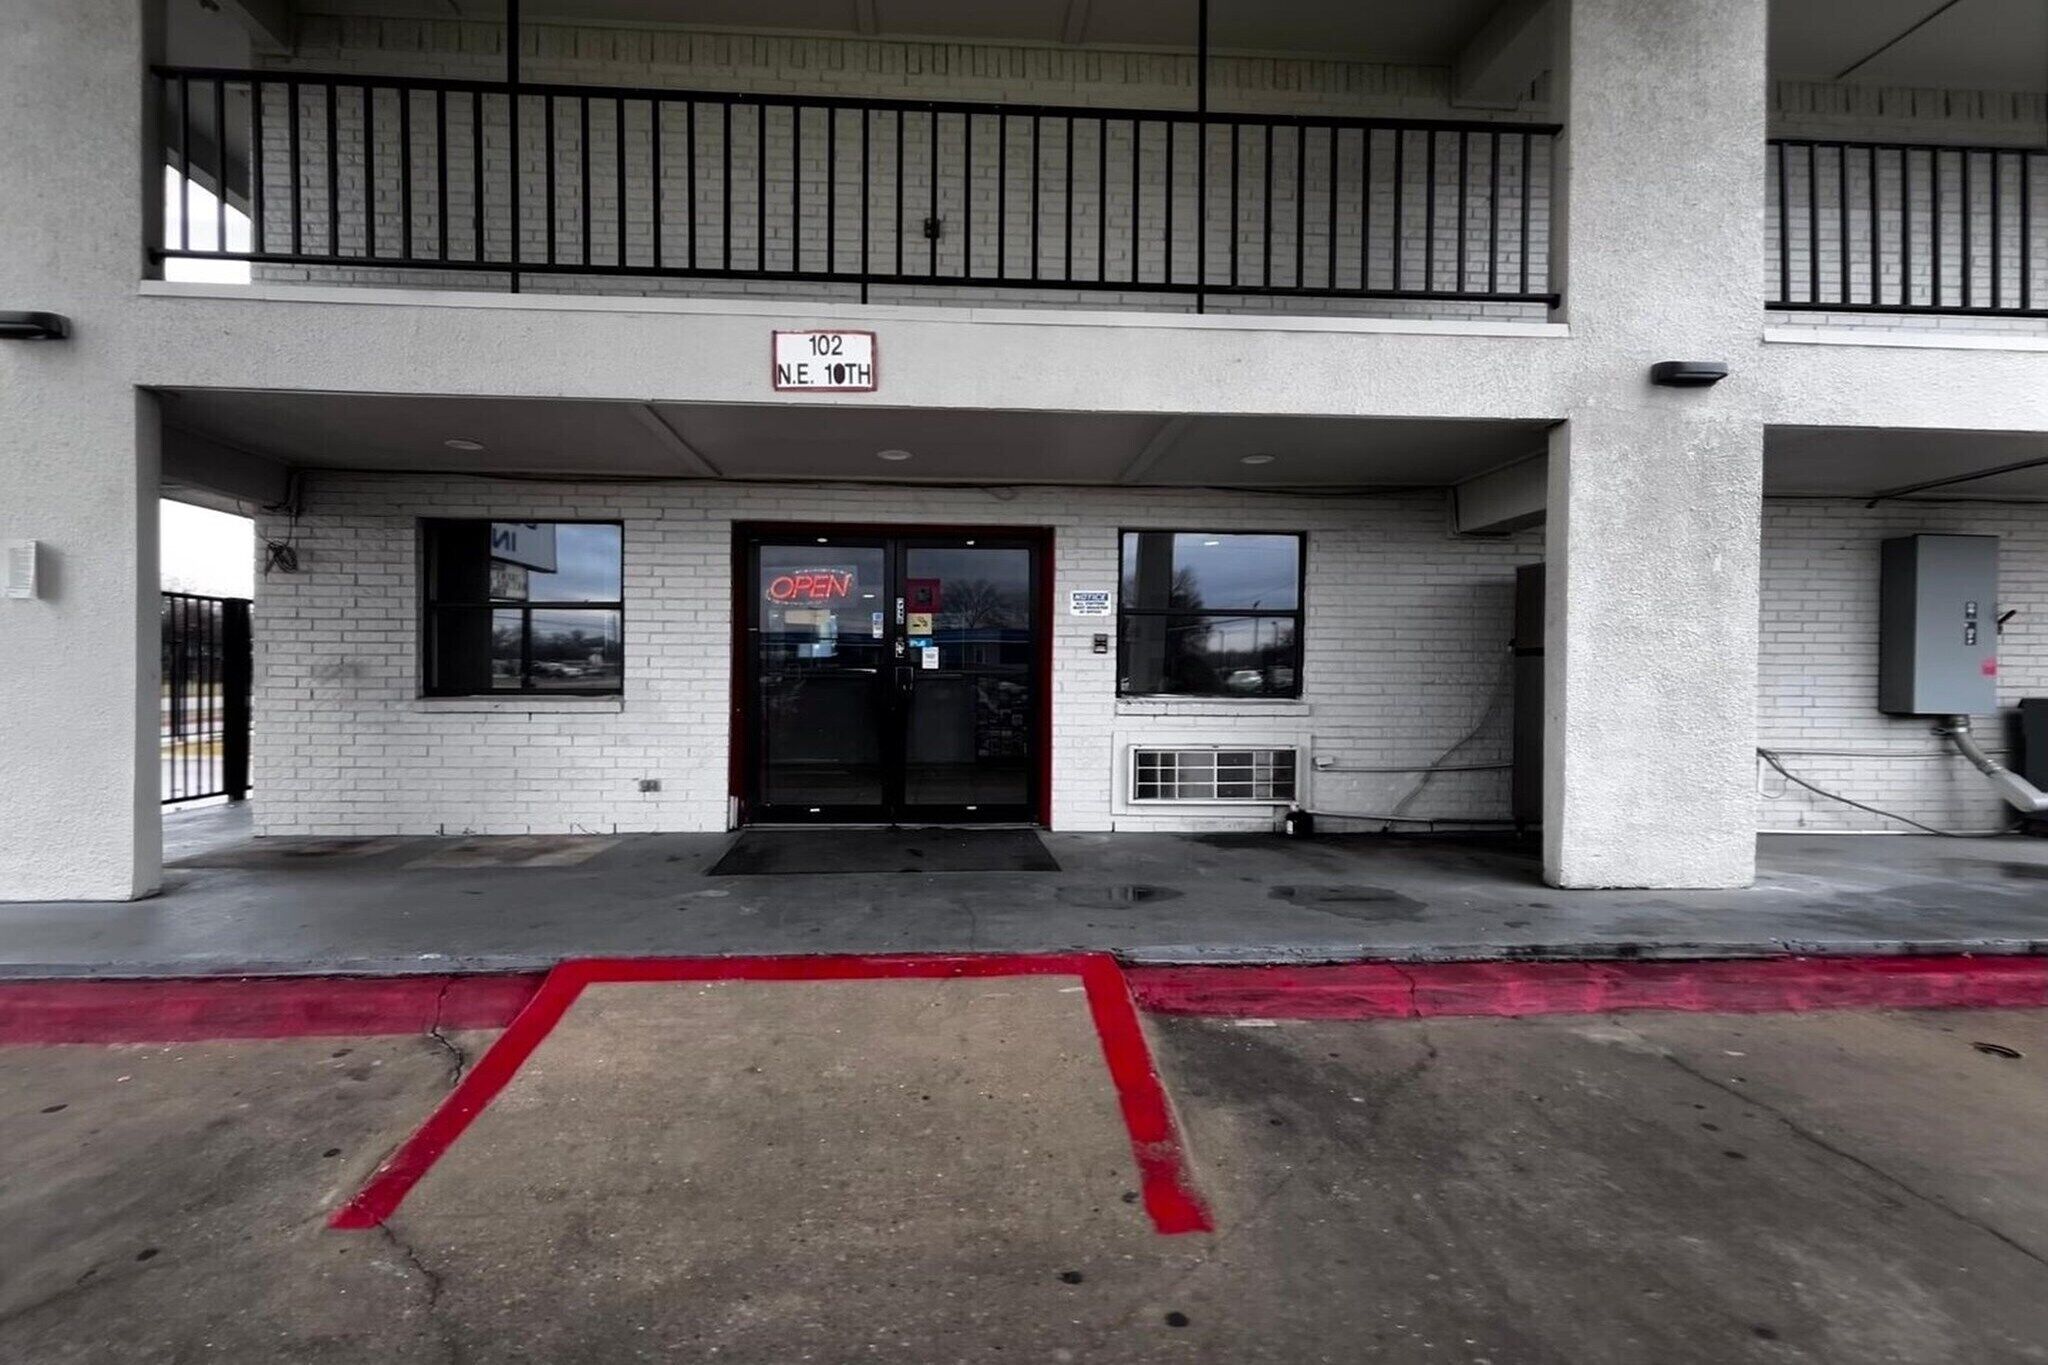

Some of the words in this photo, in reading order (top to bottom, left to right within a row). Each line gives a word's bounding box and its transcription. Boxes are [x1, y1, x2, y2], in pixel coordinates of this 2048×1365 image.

[808, 334, 843, 356] 102
[778, 363, 814, 385] N.E.
[824, 363, 871, 385] 10TH
[770, 574, 853, 599] OPEN
[1073, 593, 1107, 601] NOTICE
